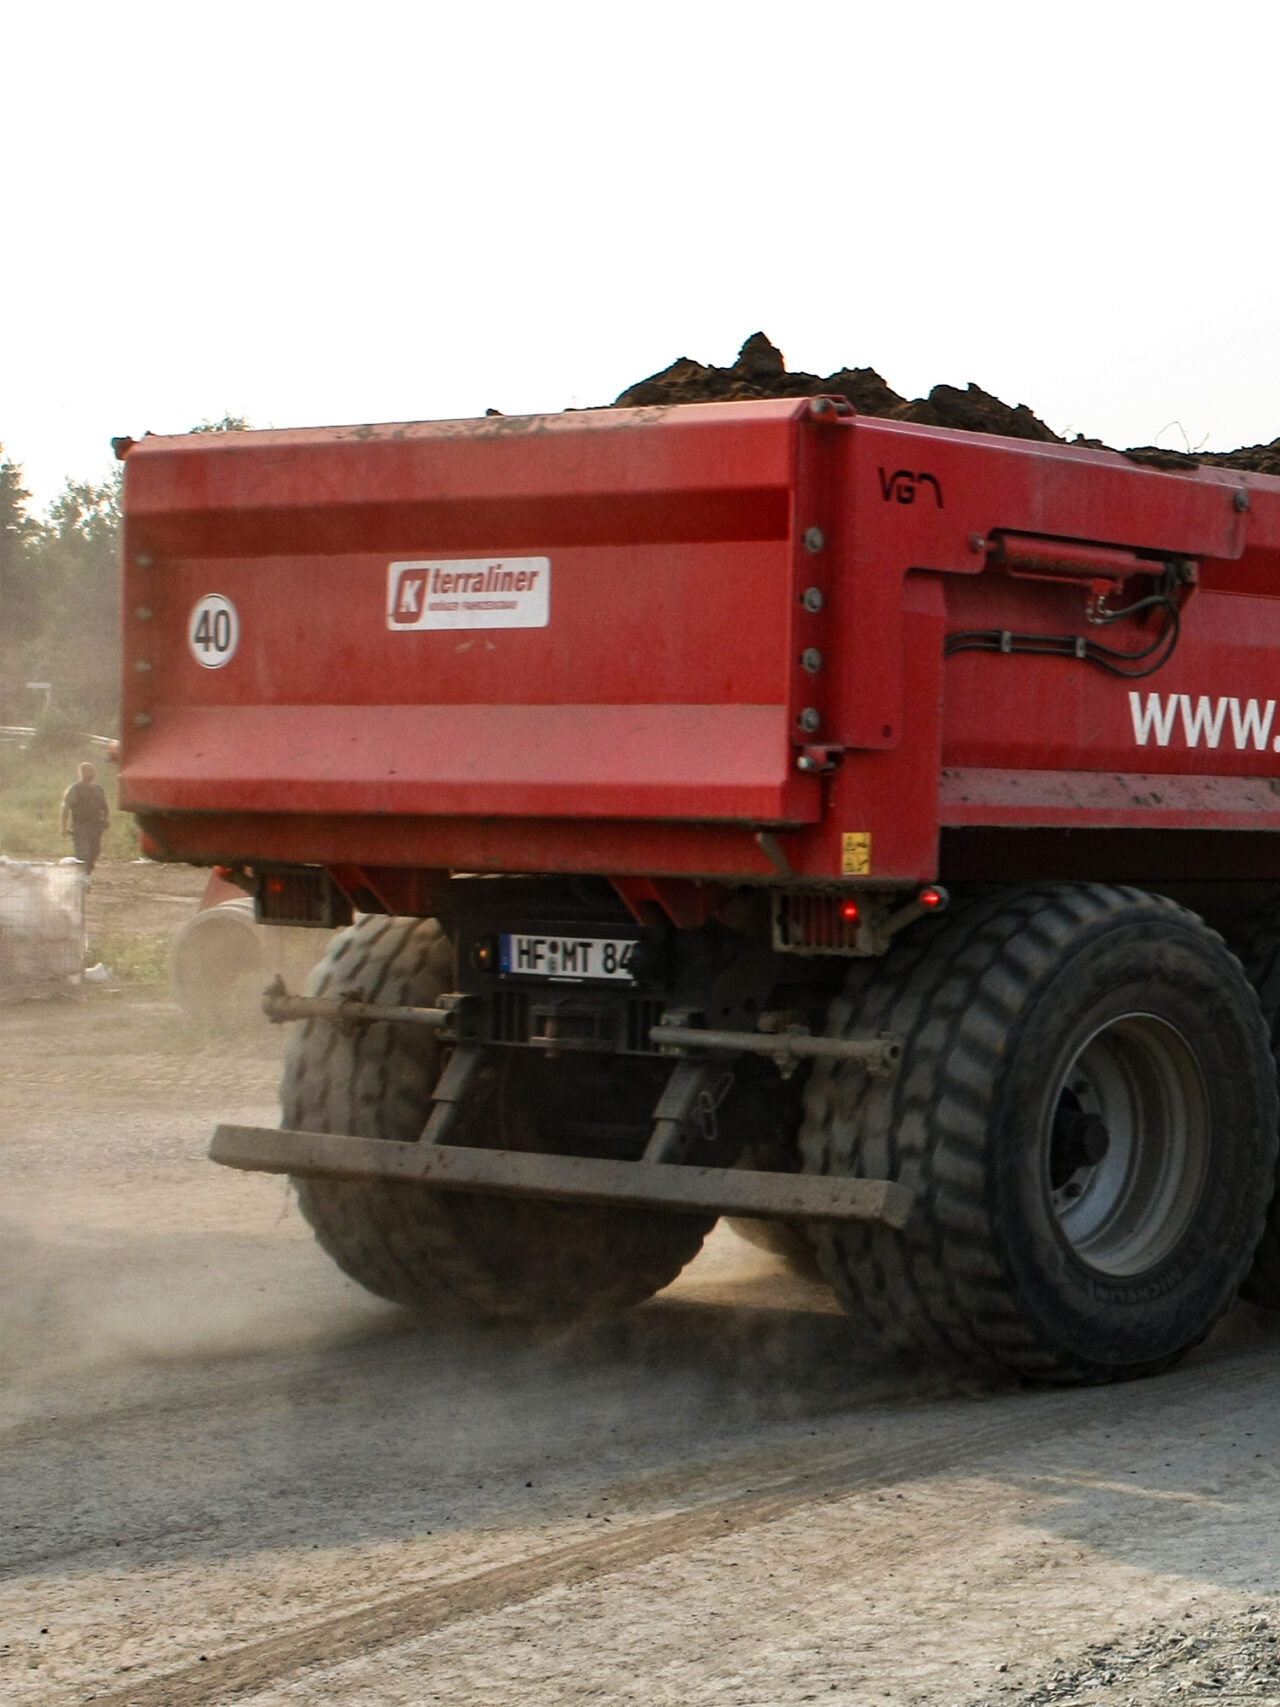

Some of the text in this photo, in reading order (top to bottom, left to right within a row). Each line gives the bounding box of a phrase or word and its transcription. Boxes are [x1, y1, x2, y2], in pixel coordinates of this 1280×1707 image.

[432, 564, 540, 594] terraliner
[194, 609, 231, 652] 40
[517, 938, 546, 969] HF
[562, 941, 593, 972] MT
